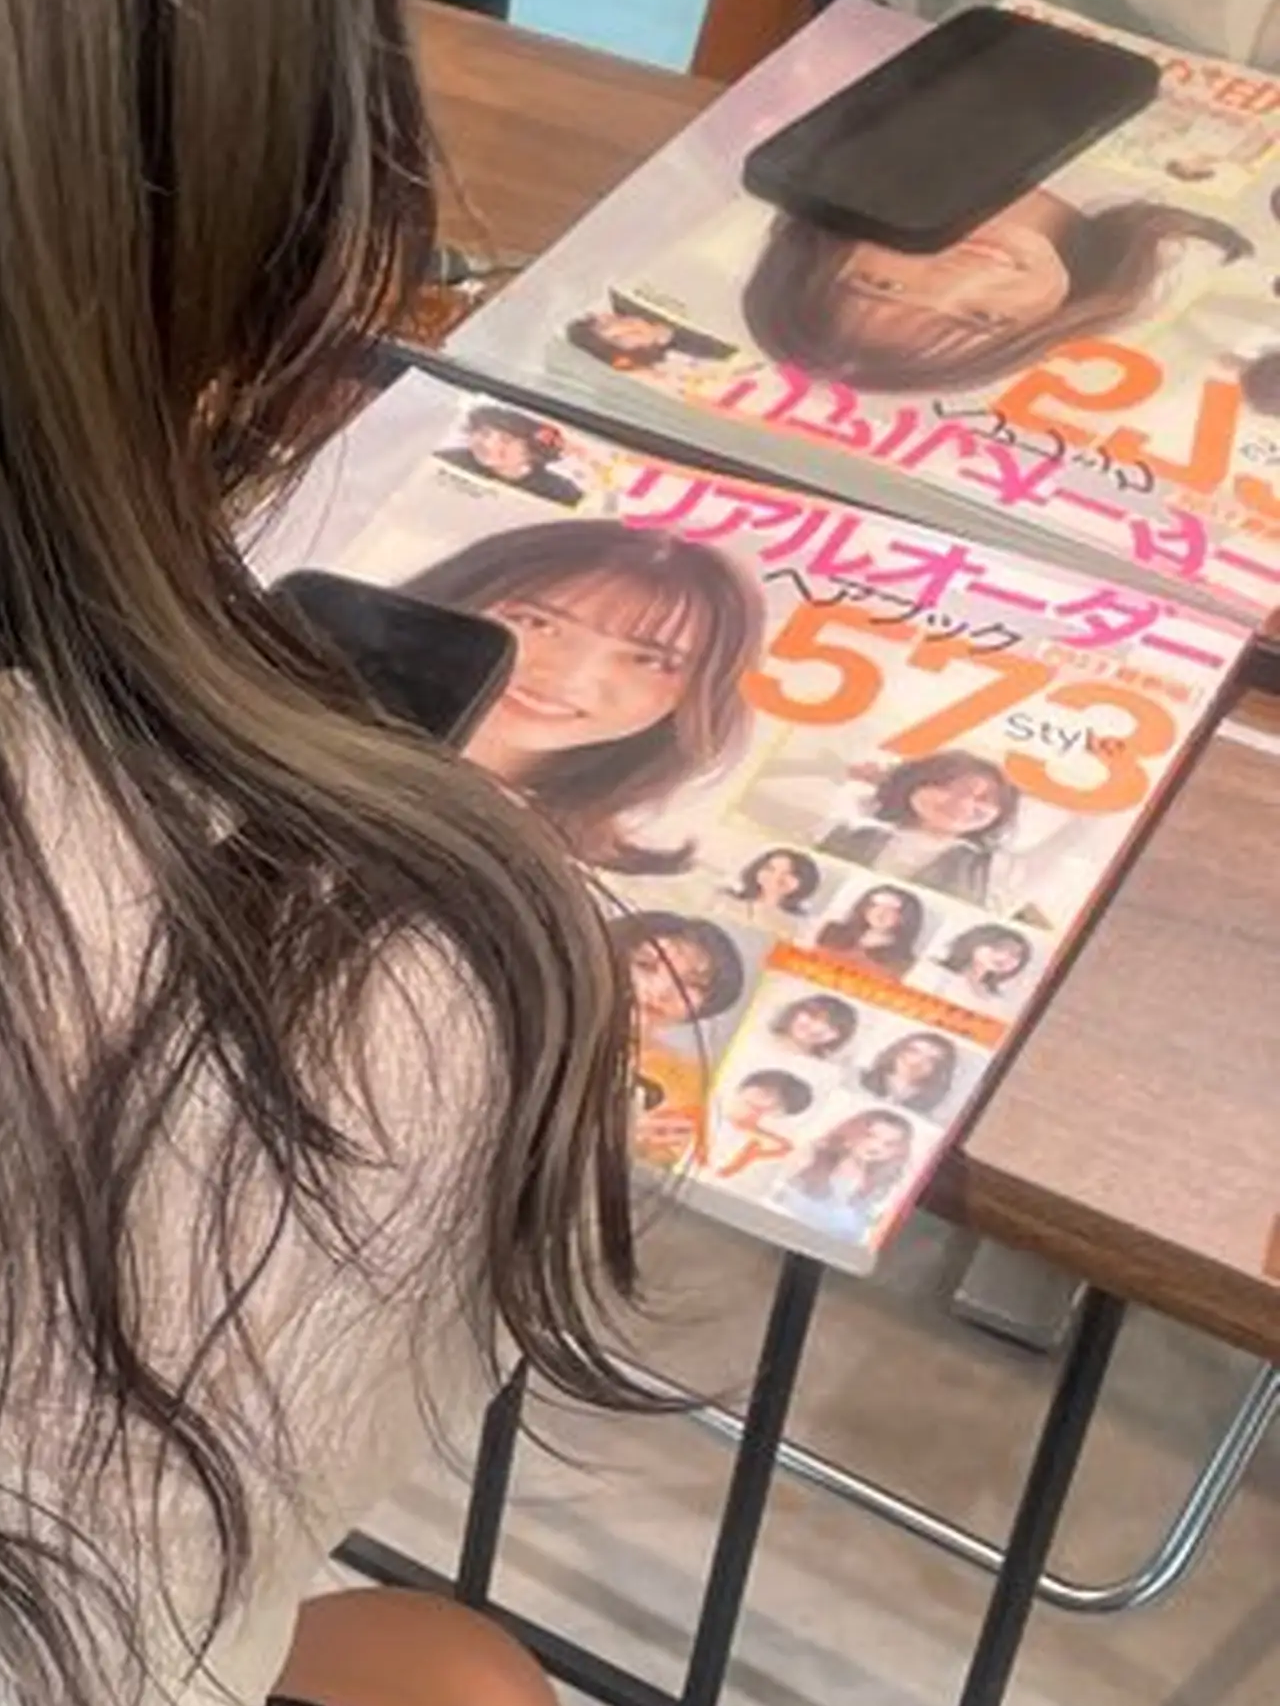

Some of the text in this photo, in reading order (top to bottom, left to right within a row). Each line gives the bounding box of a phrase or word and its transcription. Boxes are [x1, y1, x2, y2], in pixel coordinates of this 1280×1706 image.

[622, 467, 1226, 670] リアルオーダー
[763, 566, 1024, 655] ヘアブック
[739, 600, 1178, 816] 573
[1004, 711, 1130, 757] Style
